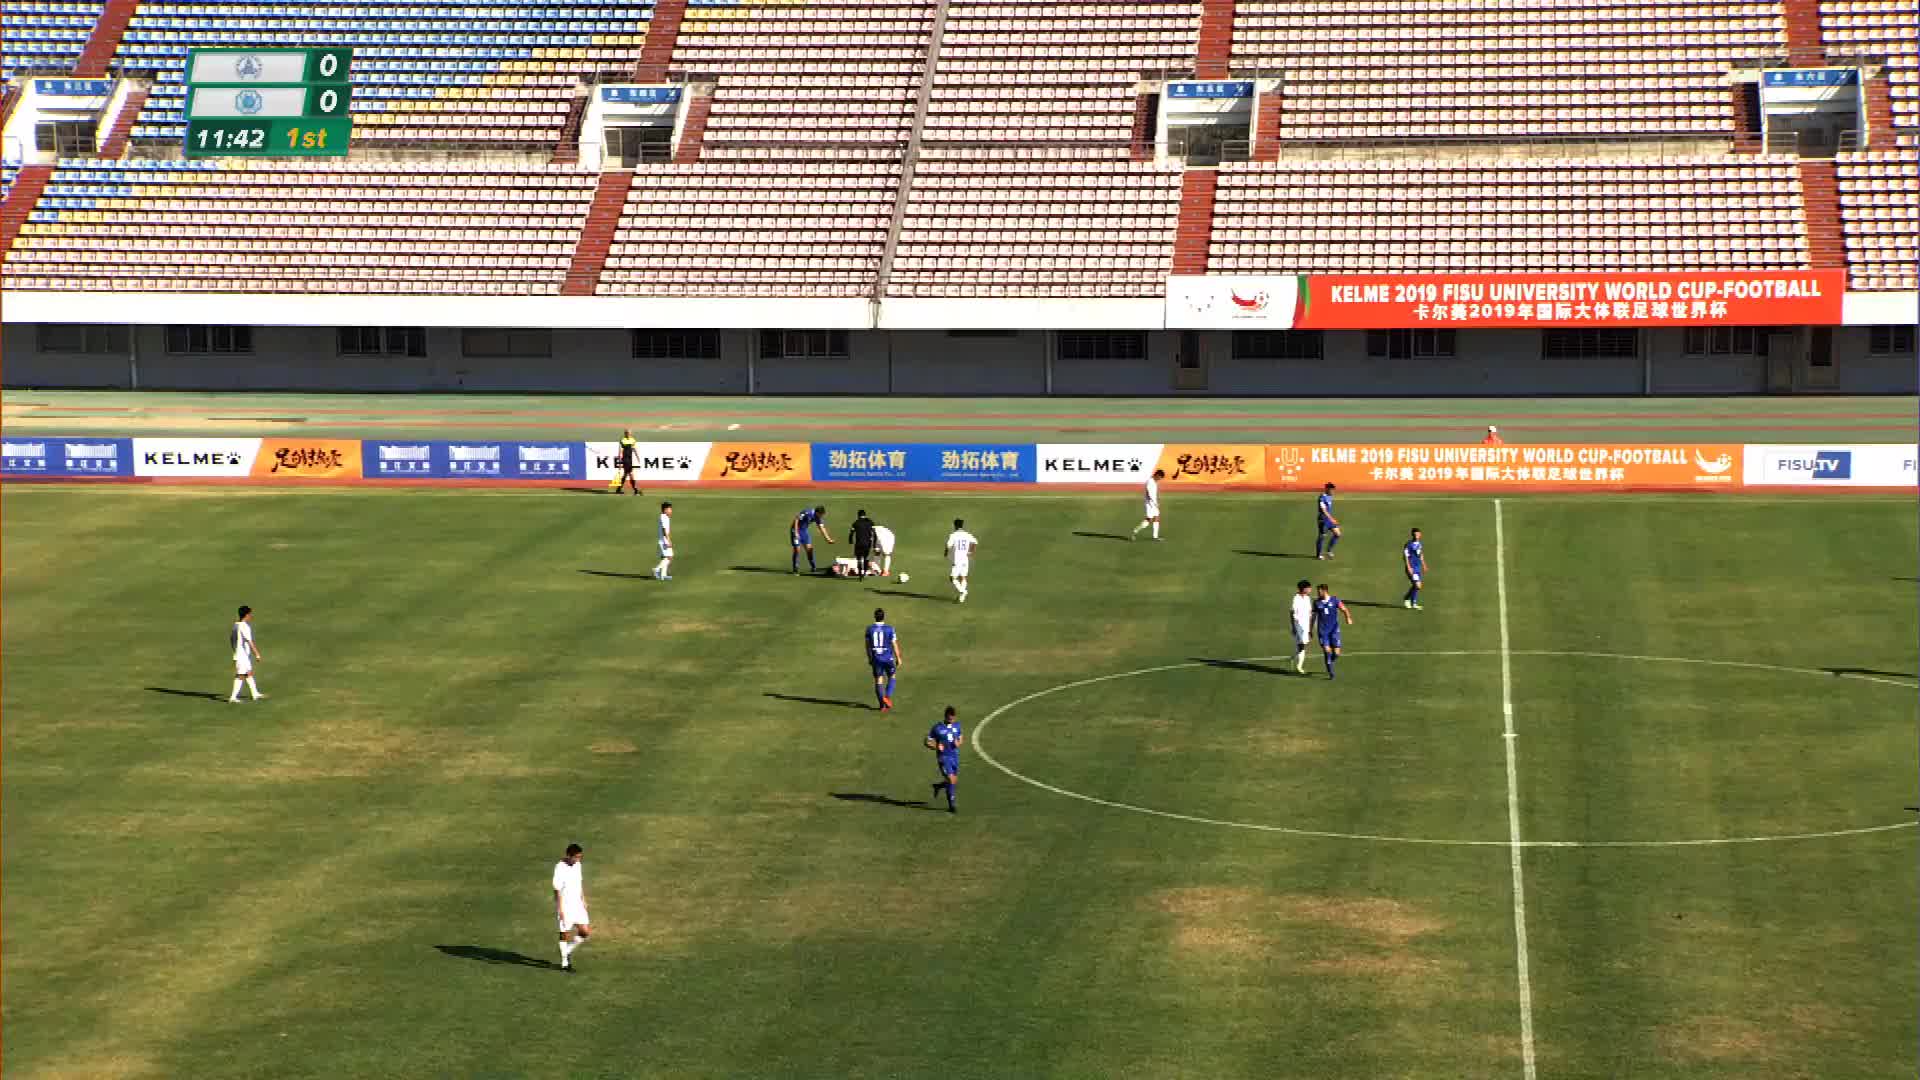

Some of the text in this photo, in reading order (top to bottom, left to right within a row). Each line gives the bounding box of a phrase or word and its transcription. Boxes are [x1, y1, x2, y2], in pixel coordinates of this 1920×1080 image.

[1331, 279, 1821, 303] KELME 2019 FISU UNIVERSITY WORLD CUP-FOOTBALL
[145, 452, 224, 465] KELME
[829, 449, 907, 470] 劲拓体育
[941, 450, 1020, 471] 劲拓体育
[1045, 459, 1125, 471] KELME
[1311, 447, 1688, 465] KELME 2019 FISU UNIVERSITY WORLD CUP-FOOTBALL
[873, 631, 884, 647] 11
